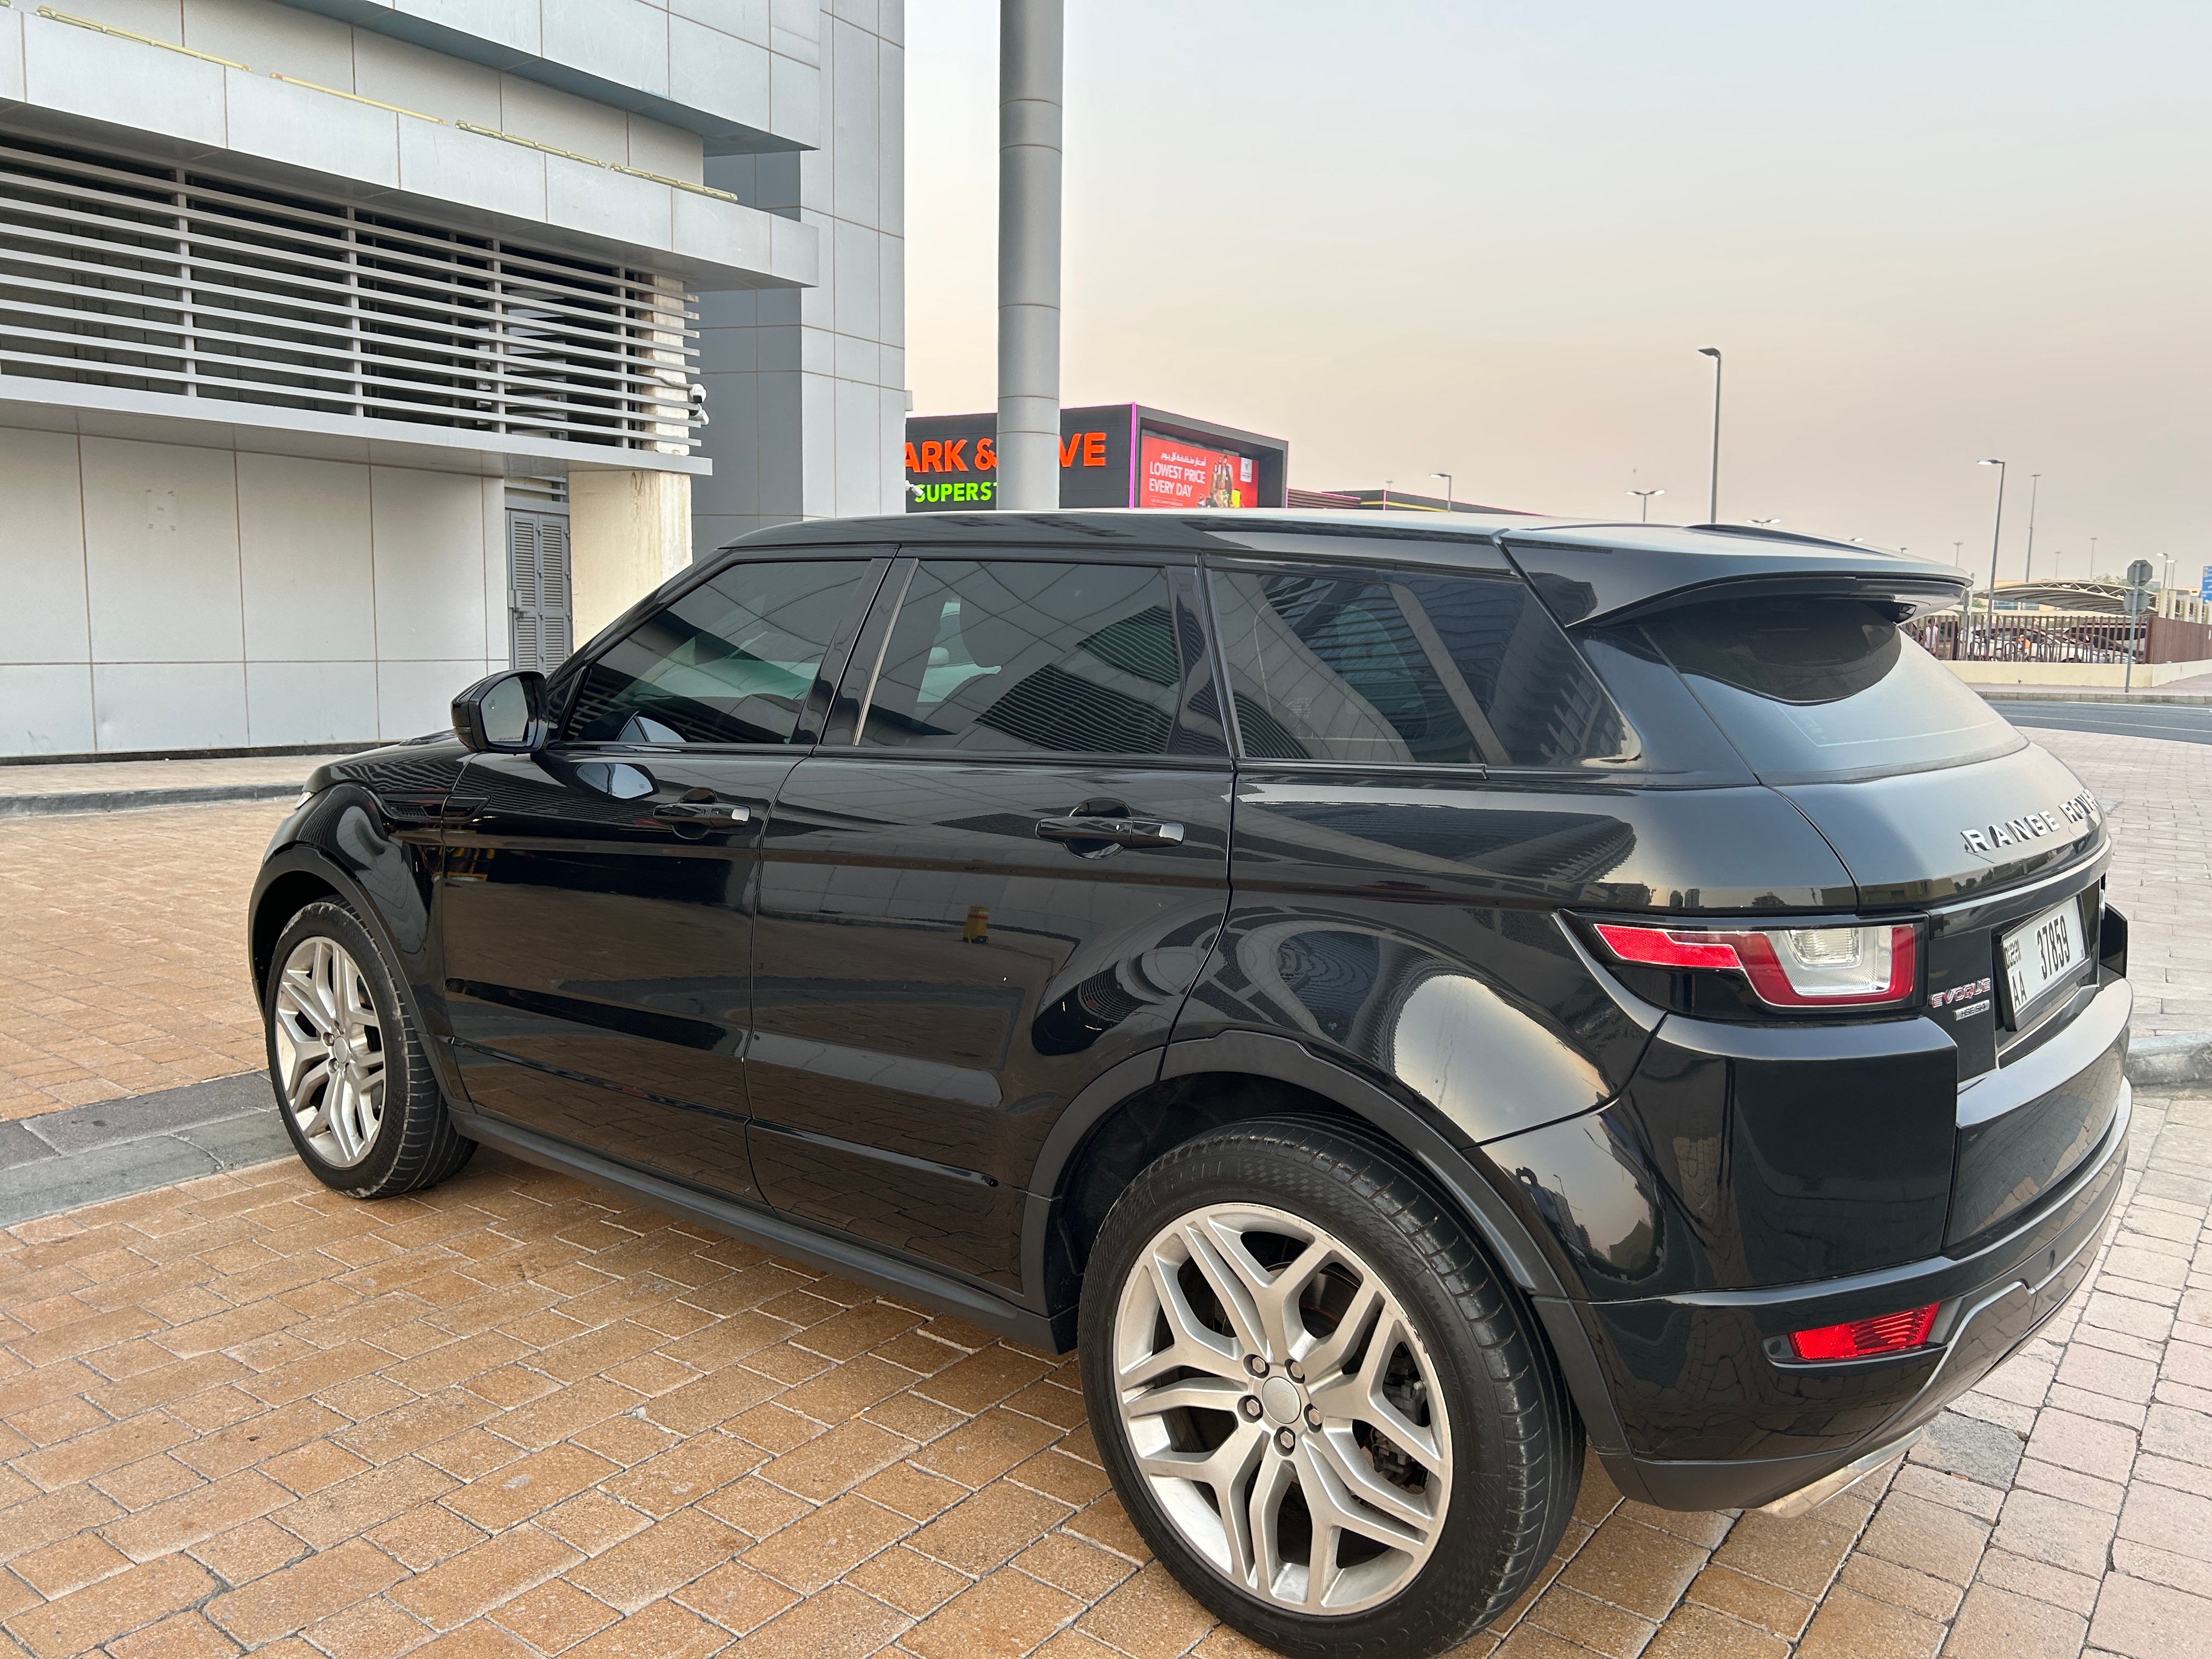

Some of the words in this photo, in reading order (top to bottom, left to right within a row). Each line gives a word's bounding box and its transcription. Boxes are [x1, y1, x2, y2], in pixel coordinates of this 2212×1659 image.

[974, 438, 997, 471] &
[1149, 461, 1183, 480] LOWEST
[1183, 467, 1206, 484] PRICE
[1149, 478, 1175, 495] EVERY
[1176, 483, 1193, 498] DAY
[1960, 810, 2060, 853] RANGE
[2036, 915, 2070, 980] 37859
[1931, 978, 1991, 1008] EVOQUE
[2012, 969, 2027, 1011] AA
[1961, 1008, 1974, 1017] HSE
